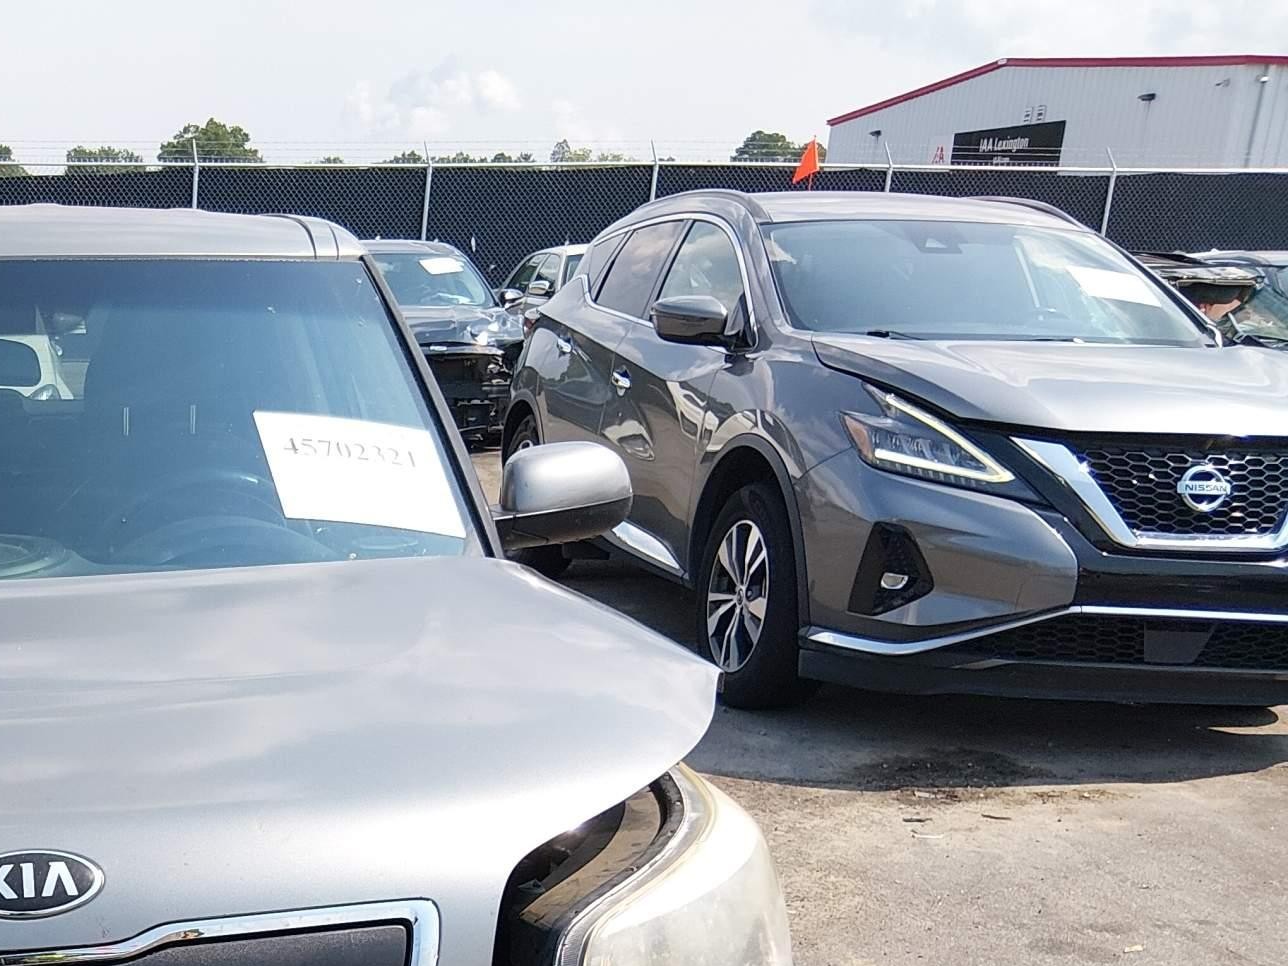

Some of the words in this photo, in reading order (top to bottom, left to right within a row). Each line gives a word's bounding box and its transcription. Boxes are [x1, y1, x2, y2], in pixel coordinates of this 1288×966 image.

[979, 138, 993, 152] IAA
[994, 136, 1029, 152] Lexington
[283, 436, 416, 468] 45702321
[1185, 483, 1227, 492] NISSAN
